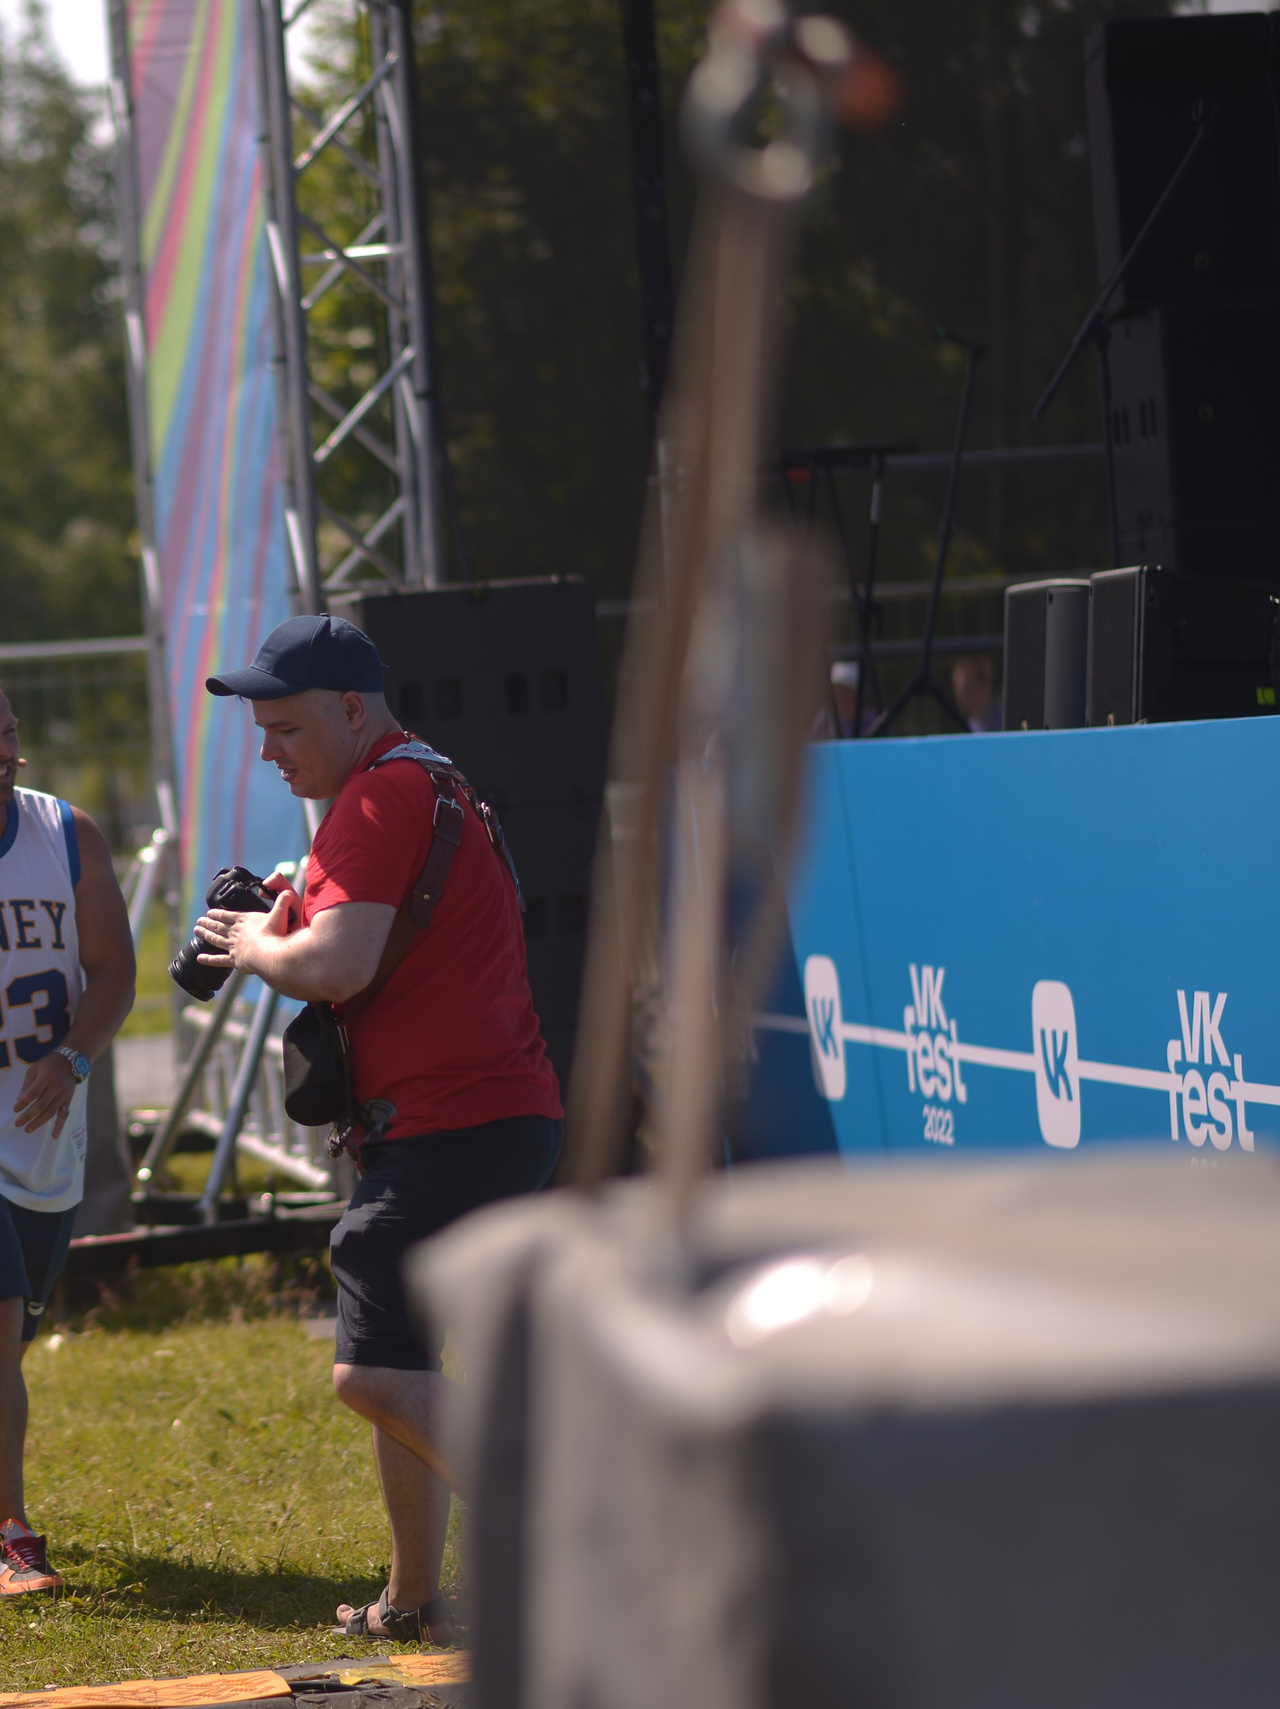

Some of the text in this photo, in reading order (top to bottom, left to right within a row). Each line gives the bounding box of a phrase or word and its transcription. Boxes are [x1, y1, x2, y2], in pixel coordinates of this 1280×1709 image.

[909, 963, 949, 1031] VK
[1176, 989, 1231, 1067] VK
[903, 1005, 967, 1104] fest
[922, 1104, 955, 1147] 2022
[1166, 1039, 1254, 1152] fest
